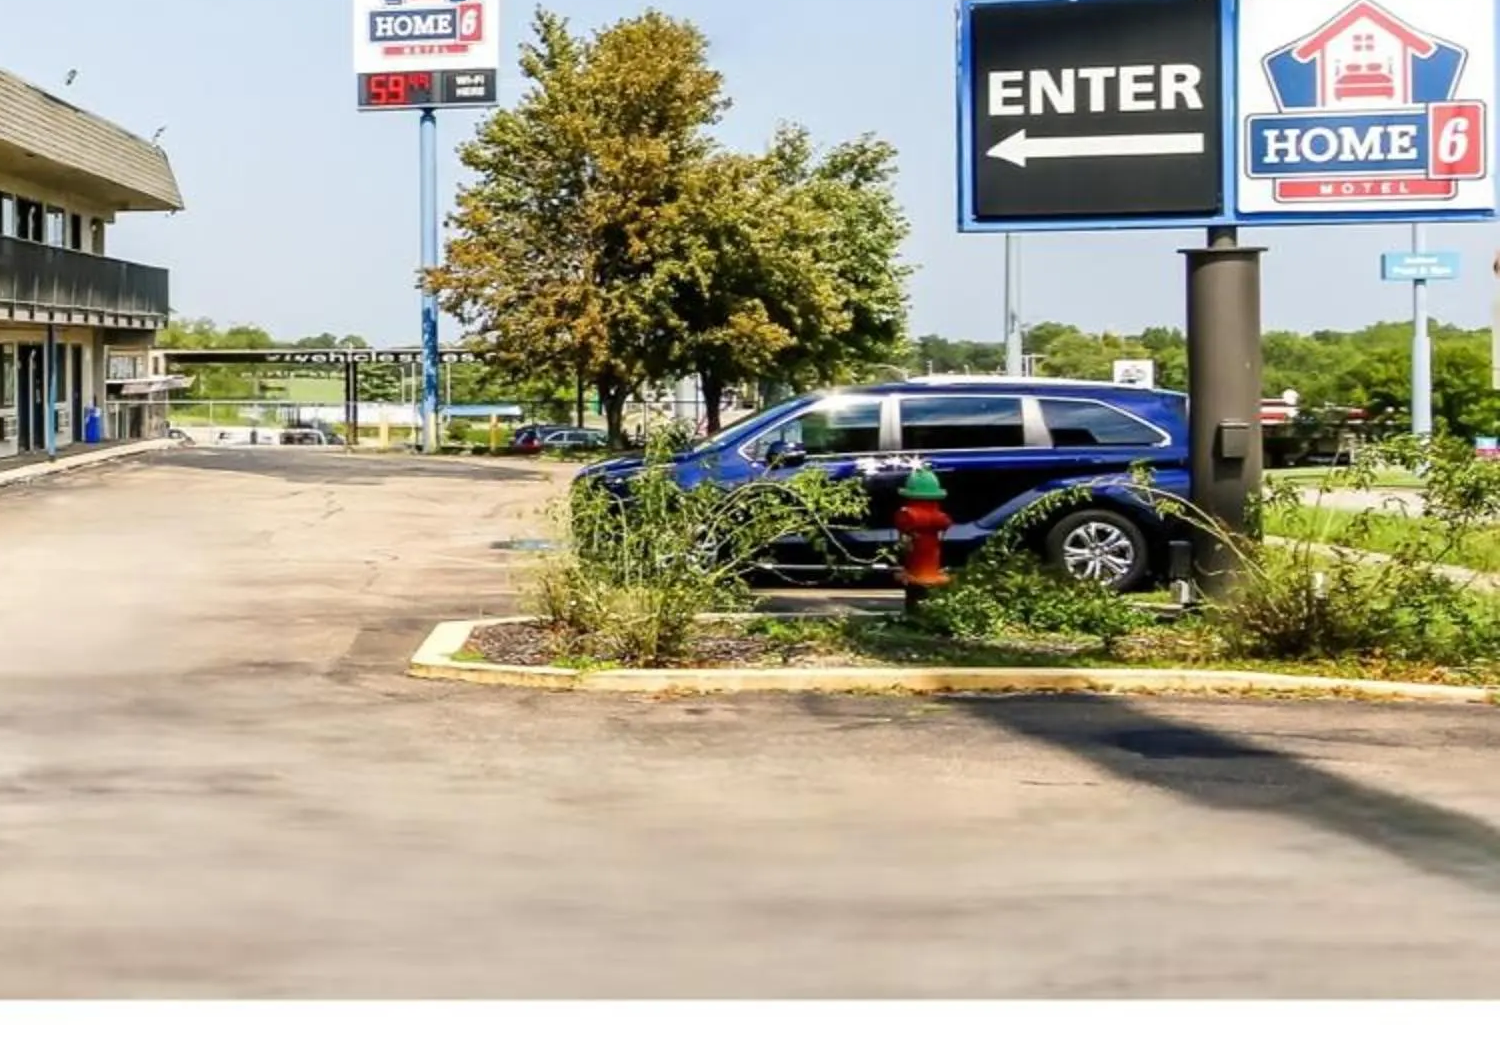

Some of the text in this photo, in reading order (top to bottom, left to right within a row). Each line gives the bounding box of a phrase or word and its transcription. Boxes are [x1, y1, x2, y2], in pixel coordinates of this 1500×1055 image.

[375, 9, 478, 37] HOME 6
[370, 75, 405, 104] 59
[987, 63, 1204, 117] ENTER
[1262, 116, 1470, 164] HOME 6
[1318, 180, 1410, 195] MOTEL
